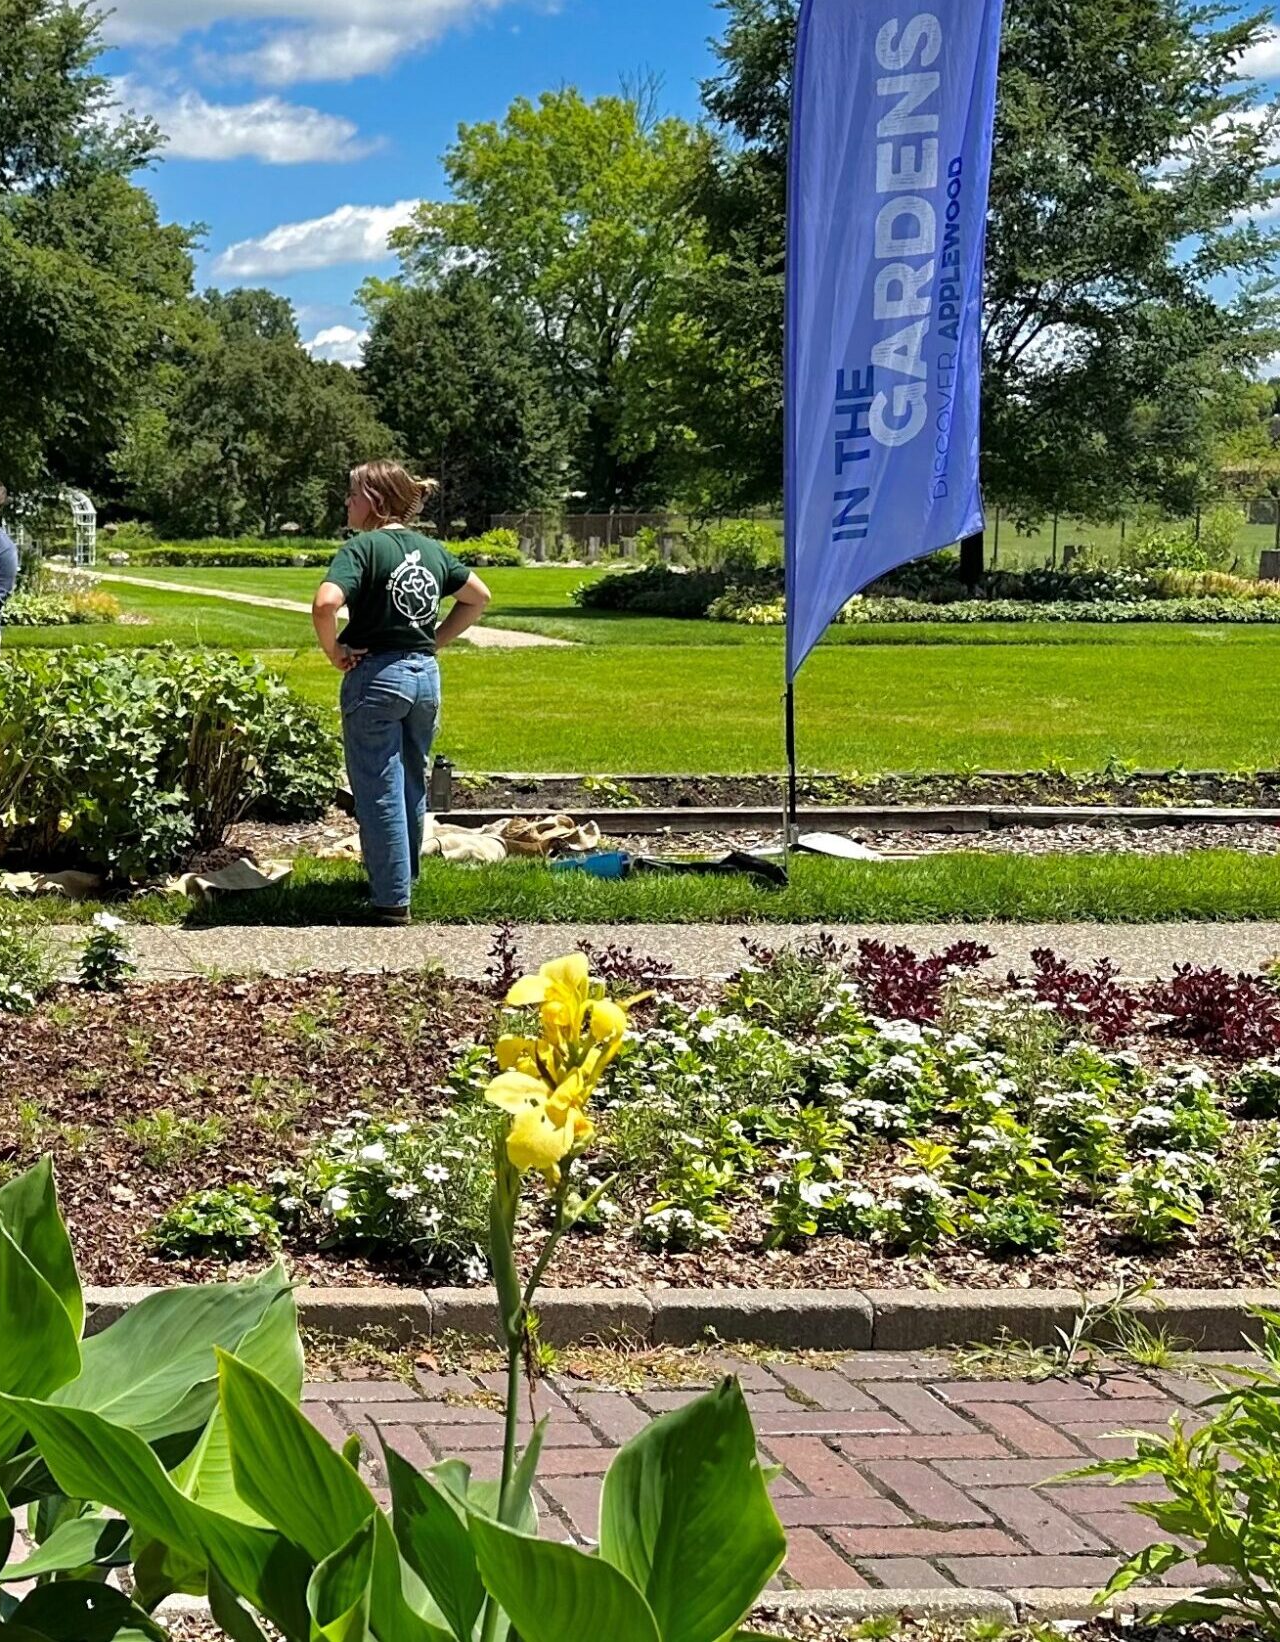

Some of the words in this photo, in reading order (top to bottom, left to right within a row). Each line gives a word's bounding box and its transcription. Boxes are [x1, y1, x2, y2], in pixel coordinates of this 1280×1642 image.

[869, 12, 942, 446] GARDENS
[937, 156, 963, 340] APPLEWOOD
[835, 365, 874, 475] THE
[933, 352, 957, 499] DISCOVER
[832, 487, 869, 542] IN
